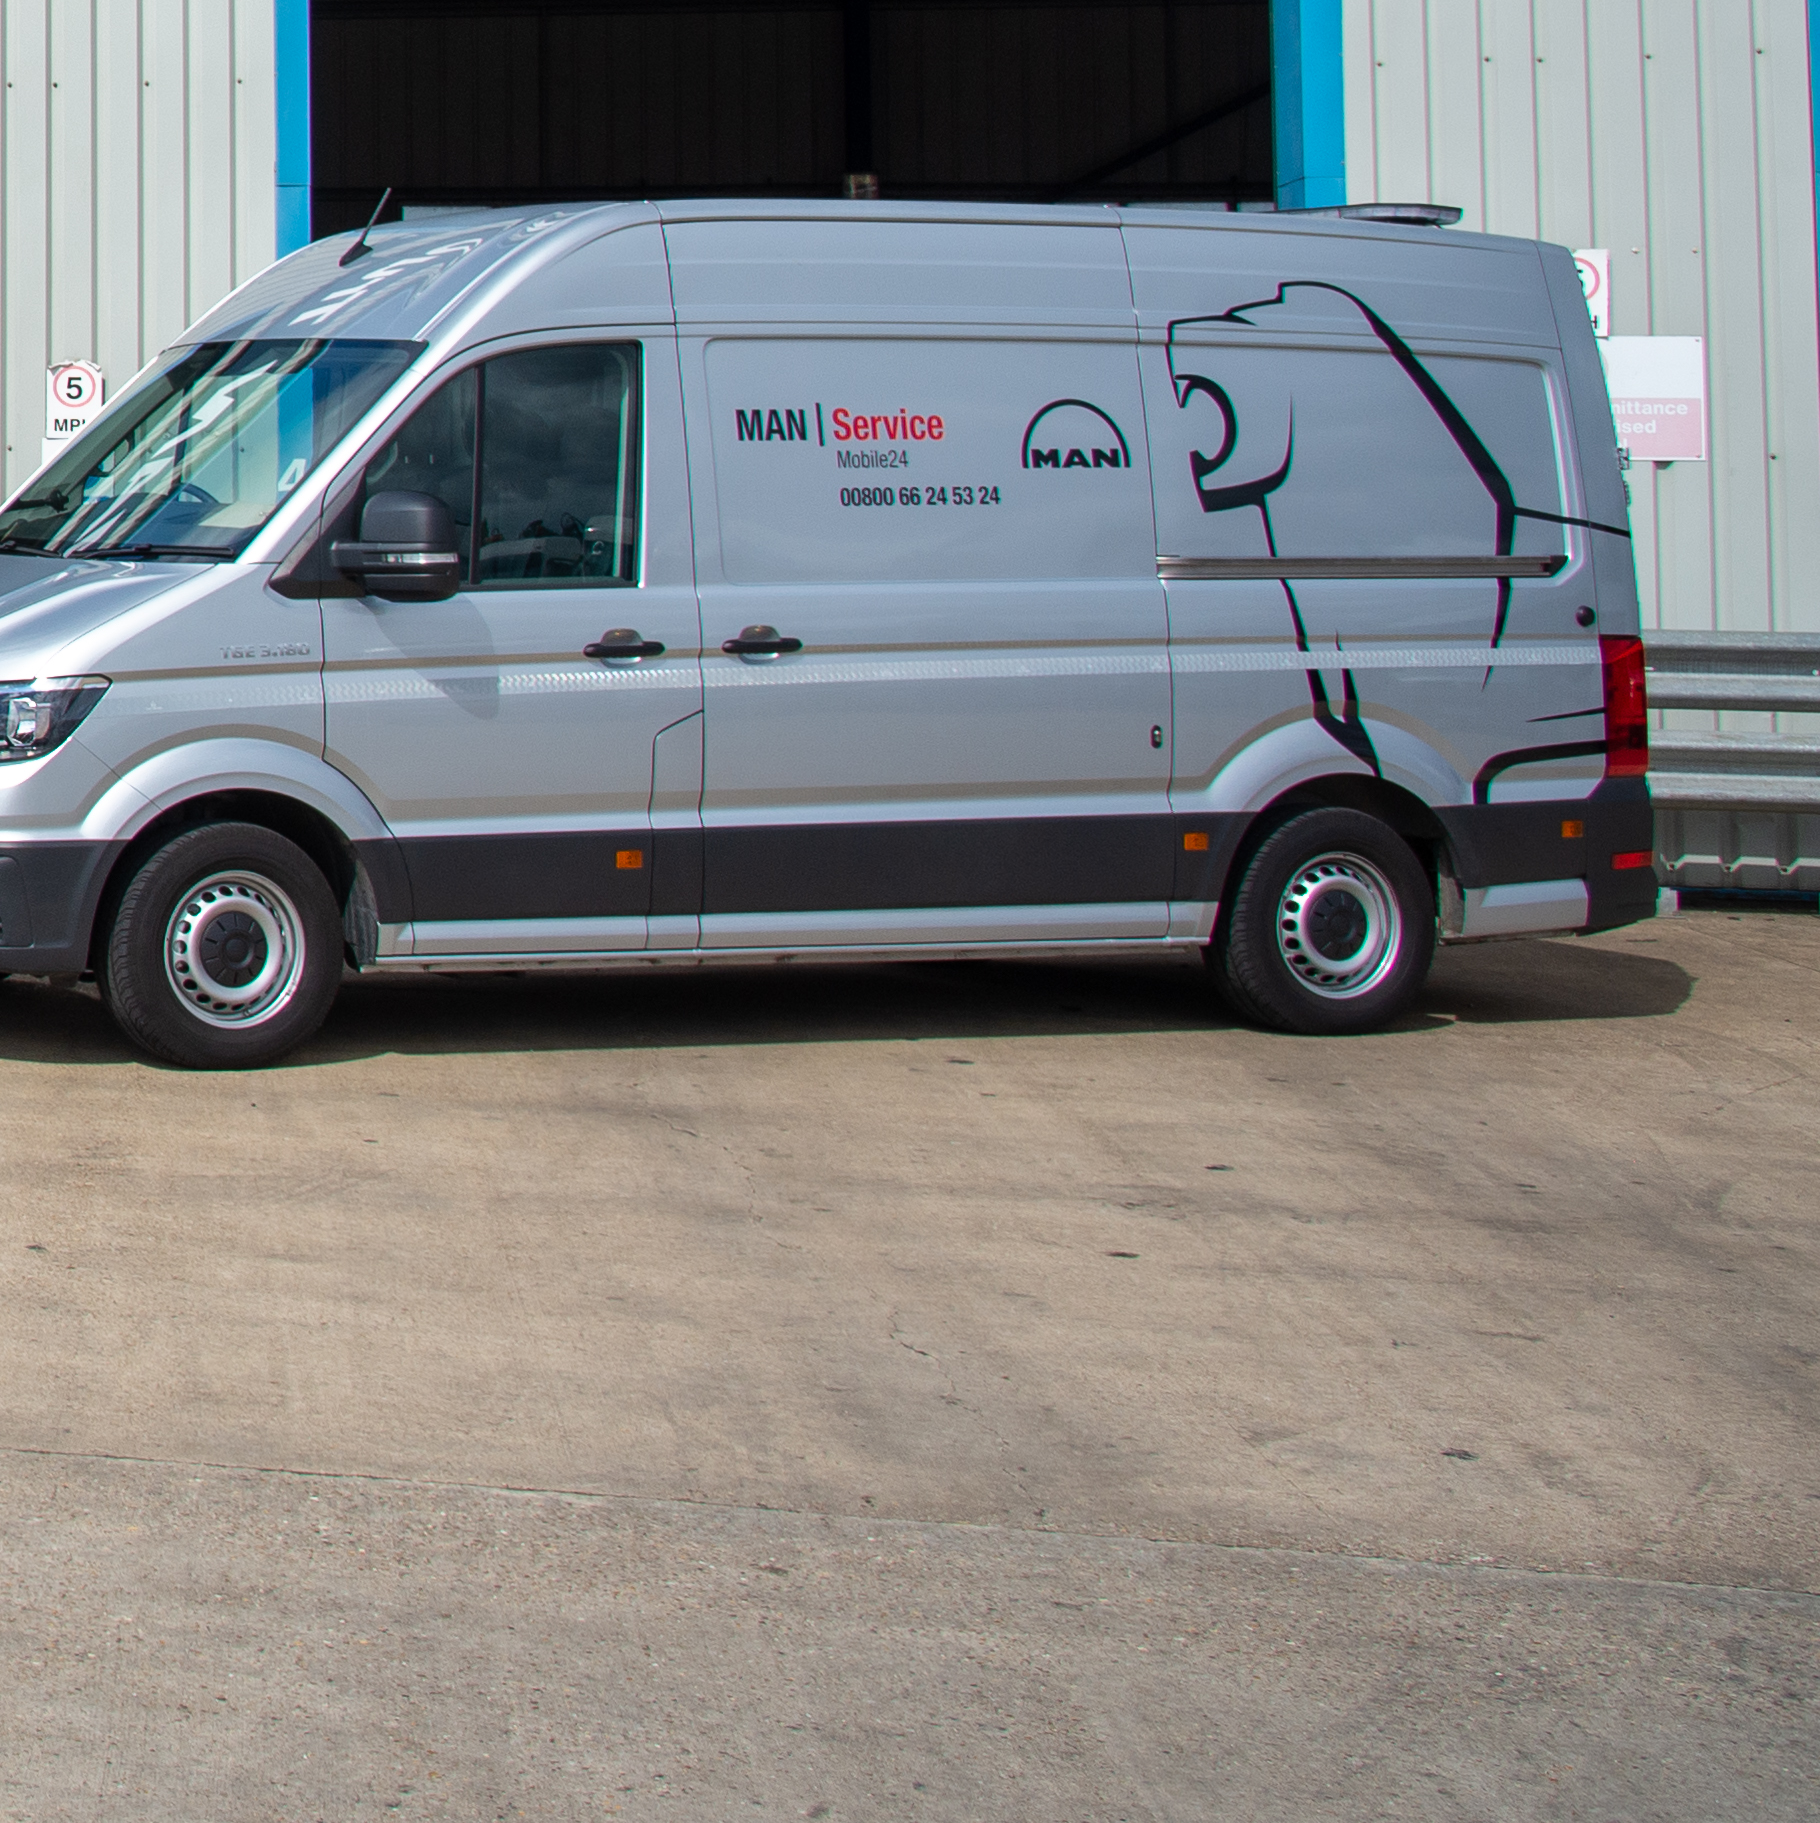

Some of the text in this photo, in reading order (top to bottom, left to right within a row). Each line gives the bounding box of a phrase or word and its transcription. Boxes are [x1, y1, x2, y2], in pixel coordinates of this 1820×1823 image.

[65, 376, 83, 400] 5
[53, 418, 86, 432] MP
[735, 407, 945, 442] MAN Service
[836, 449, 910, 469] Mobile24
[1030, 448, 1121, 469] MAN
[840, 485, 1001, 506] 00800 66 24 53 24
[219, 642, 311, 659] TGE 3.180
